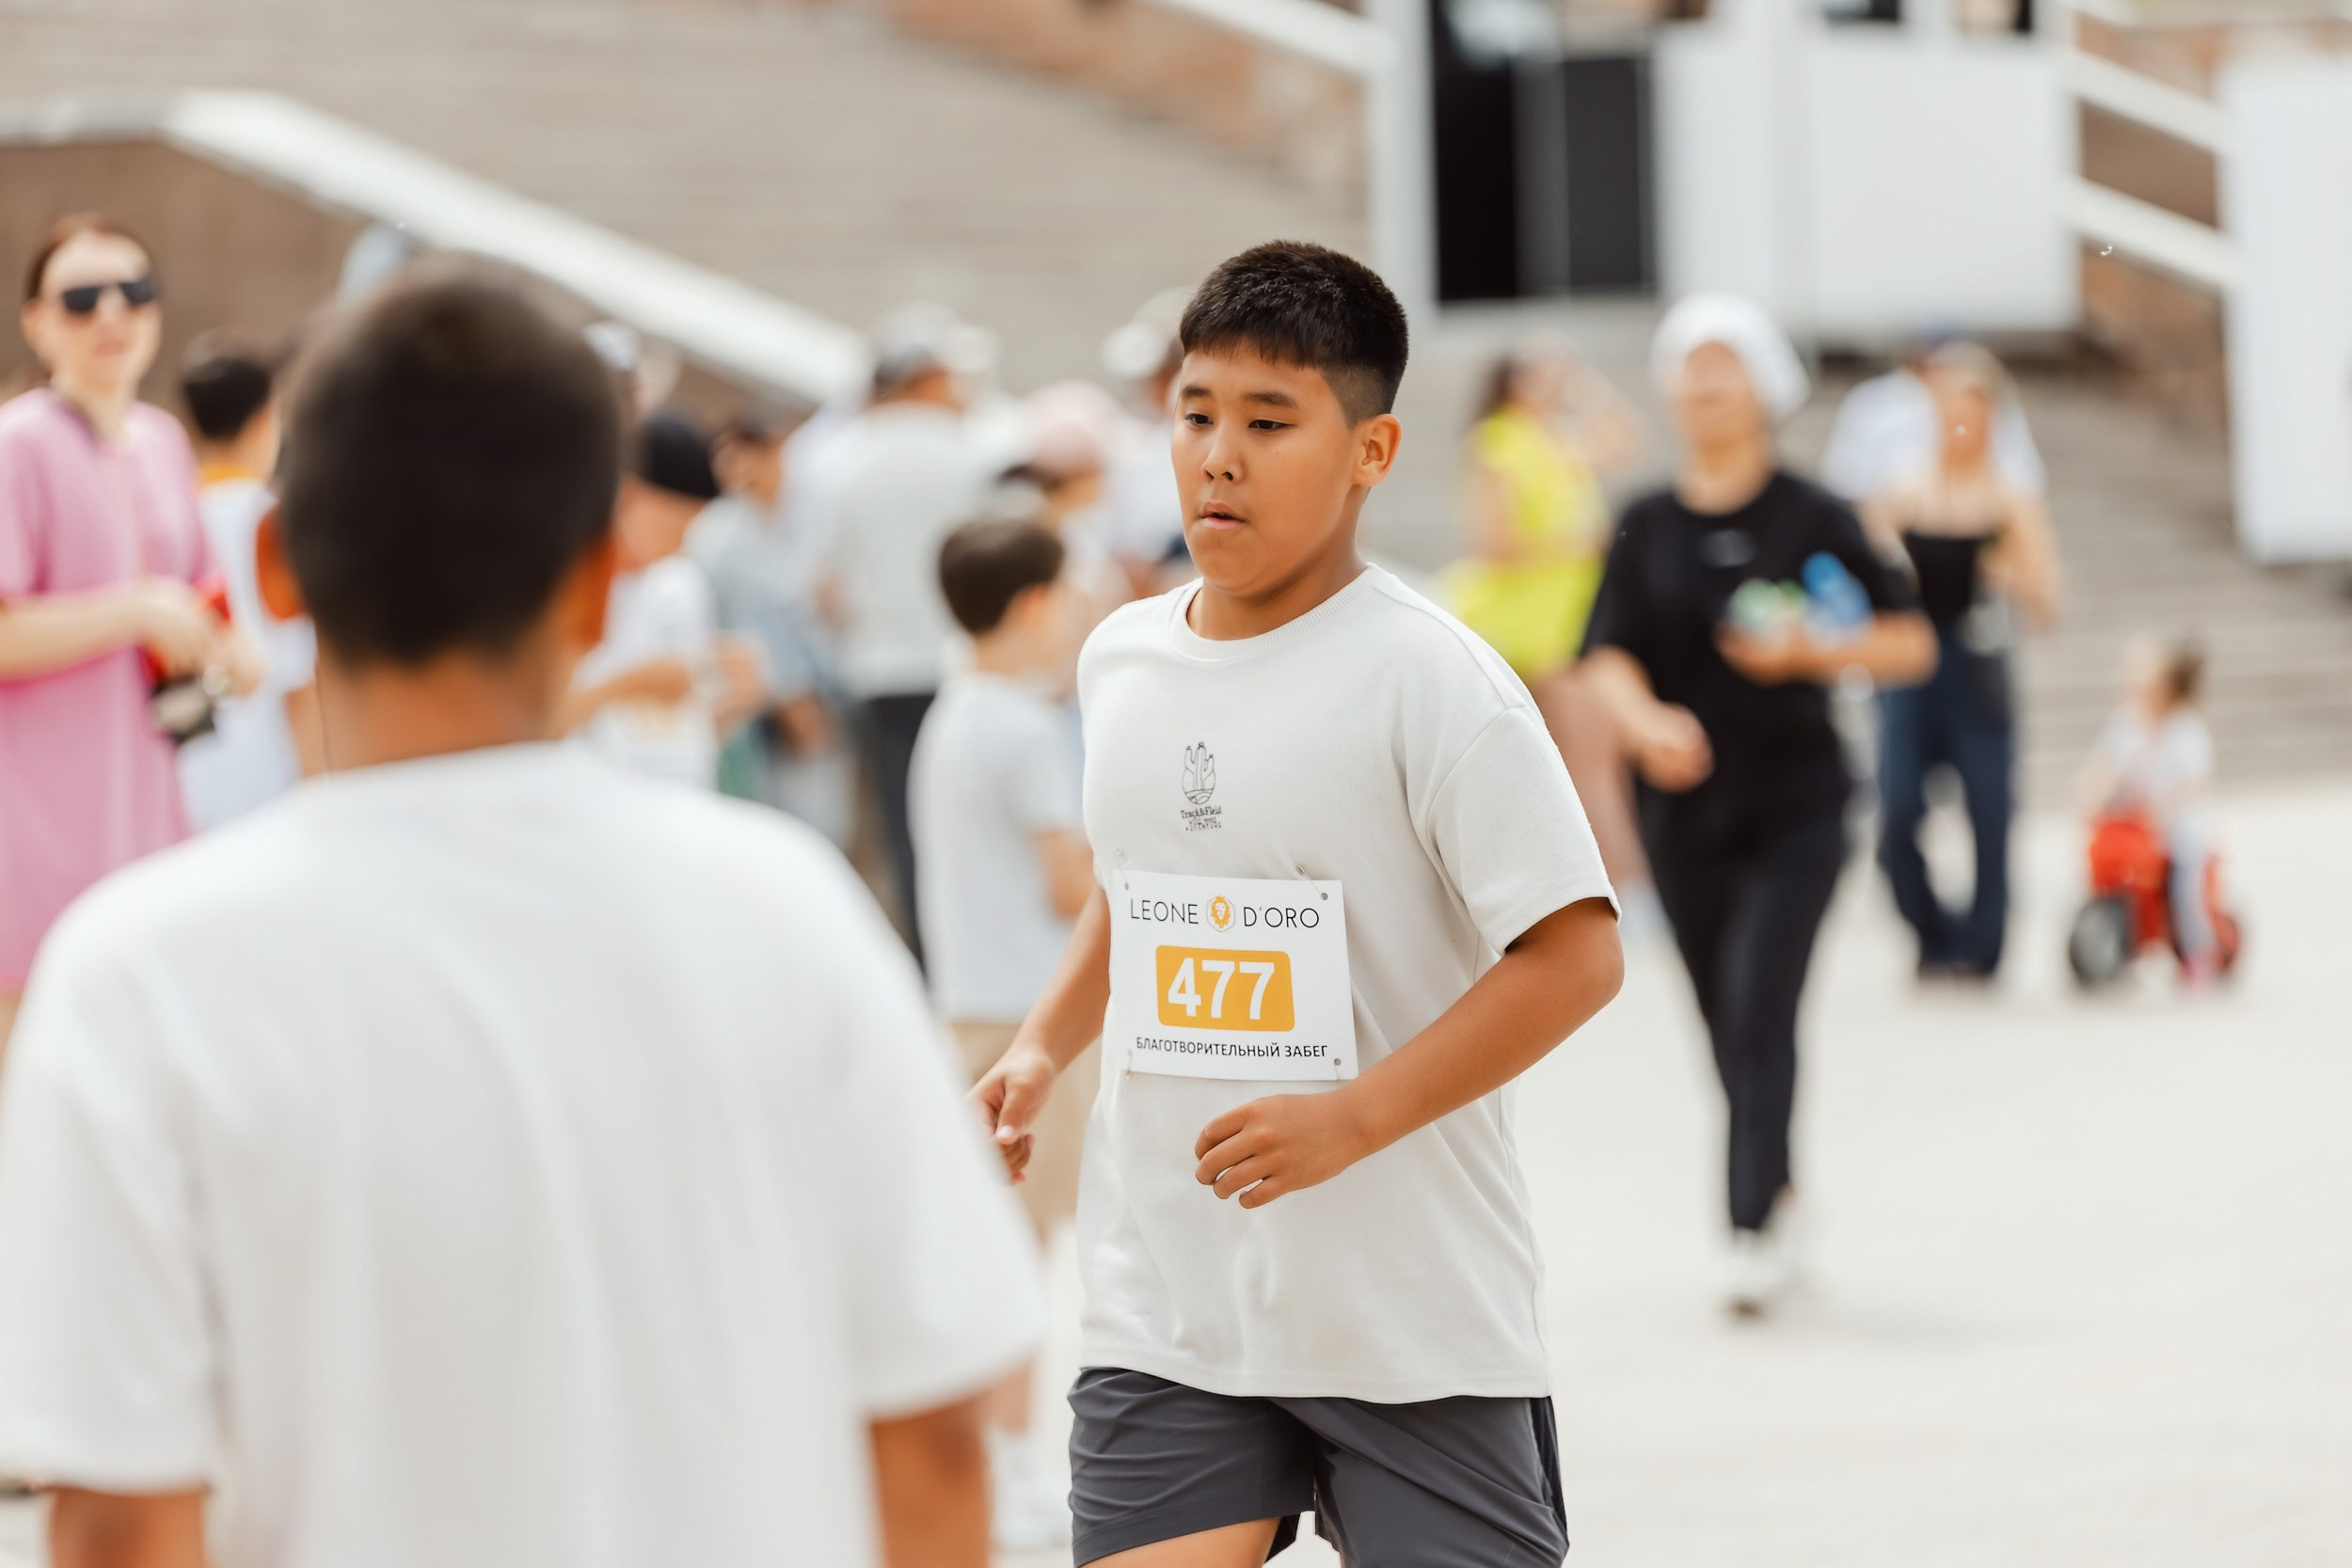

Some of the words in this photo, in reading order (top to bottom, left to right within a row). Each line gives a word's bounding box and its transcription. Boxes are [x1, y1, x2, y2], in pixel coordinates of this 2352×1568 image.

[1130, 898, 1199, 925] LEONE
[1243, 906, 1320, 928] D'ORO
[1168, 957, 1275, 1021] 477
[1136, 1037, 1279, 1057] БЛАГОТВОРИТЕЛЬНЫЙ
[1284, 1045, 1328, 1057] ЗАБЕГ
